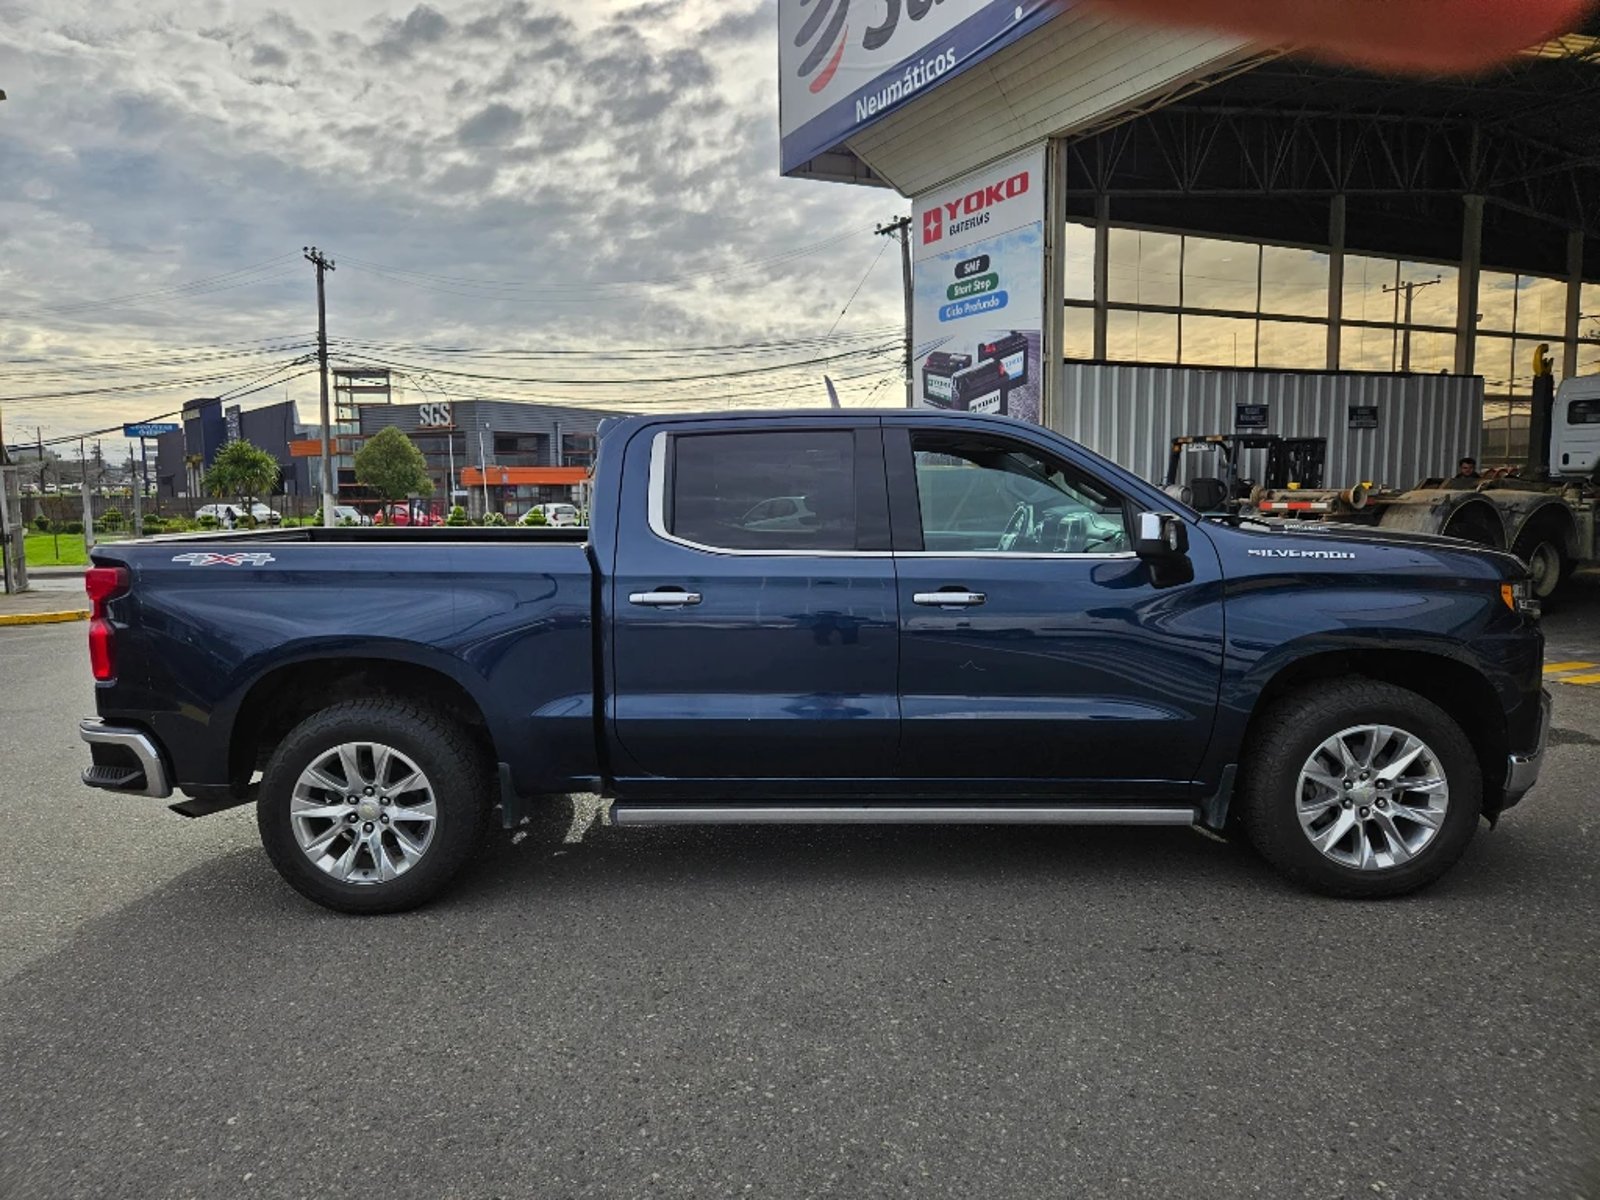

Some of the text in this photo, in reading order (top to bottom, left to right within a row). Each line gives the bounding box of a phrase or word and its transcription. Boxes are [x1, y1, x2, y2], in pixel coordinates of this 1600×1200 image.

[855, 46, 956, 122] Neumáticos
[944, 171, 1029, 221] YOKO
[964, 260, 981, 274] SMF
[954, 279, 991, 296] Start Stop
[946, 295, 1000, 318] Ciclo Profundo
[420, 402, 450, 425] SGS
